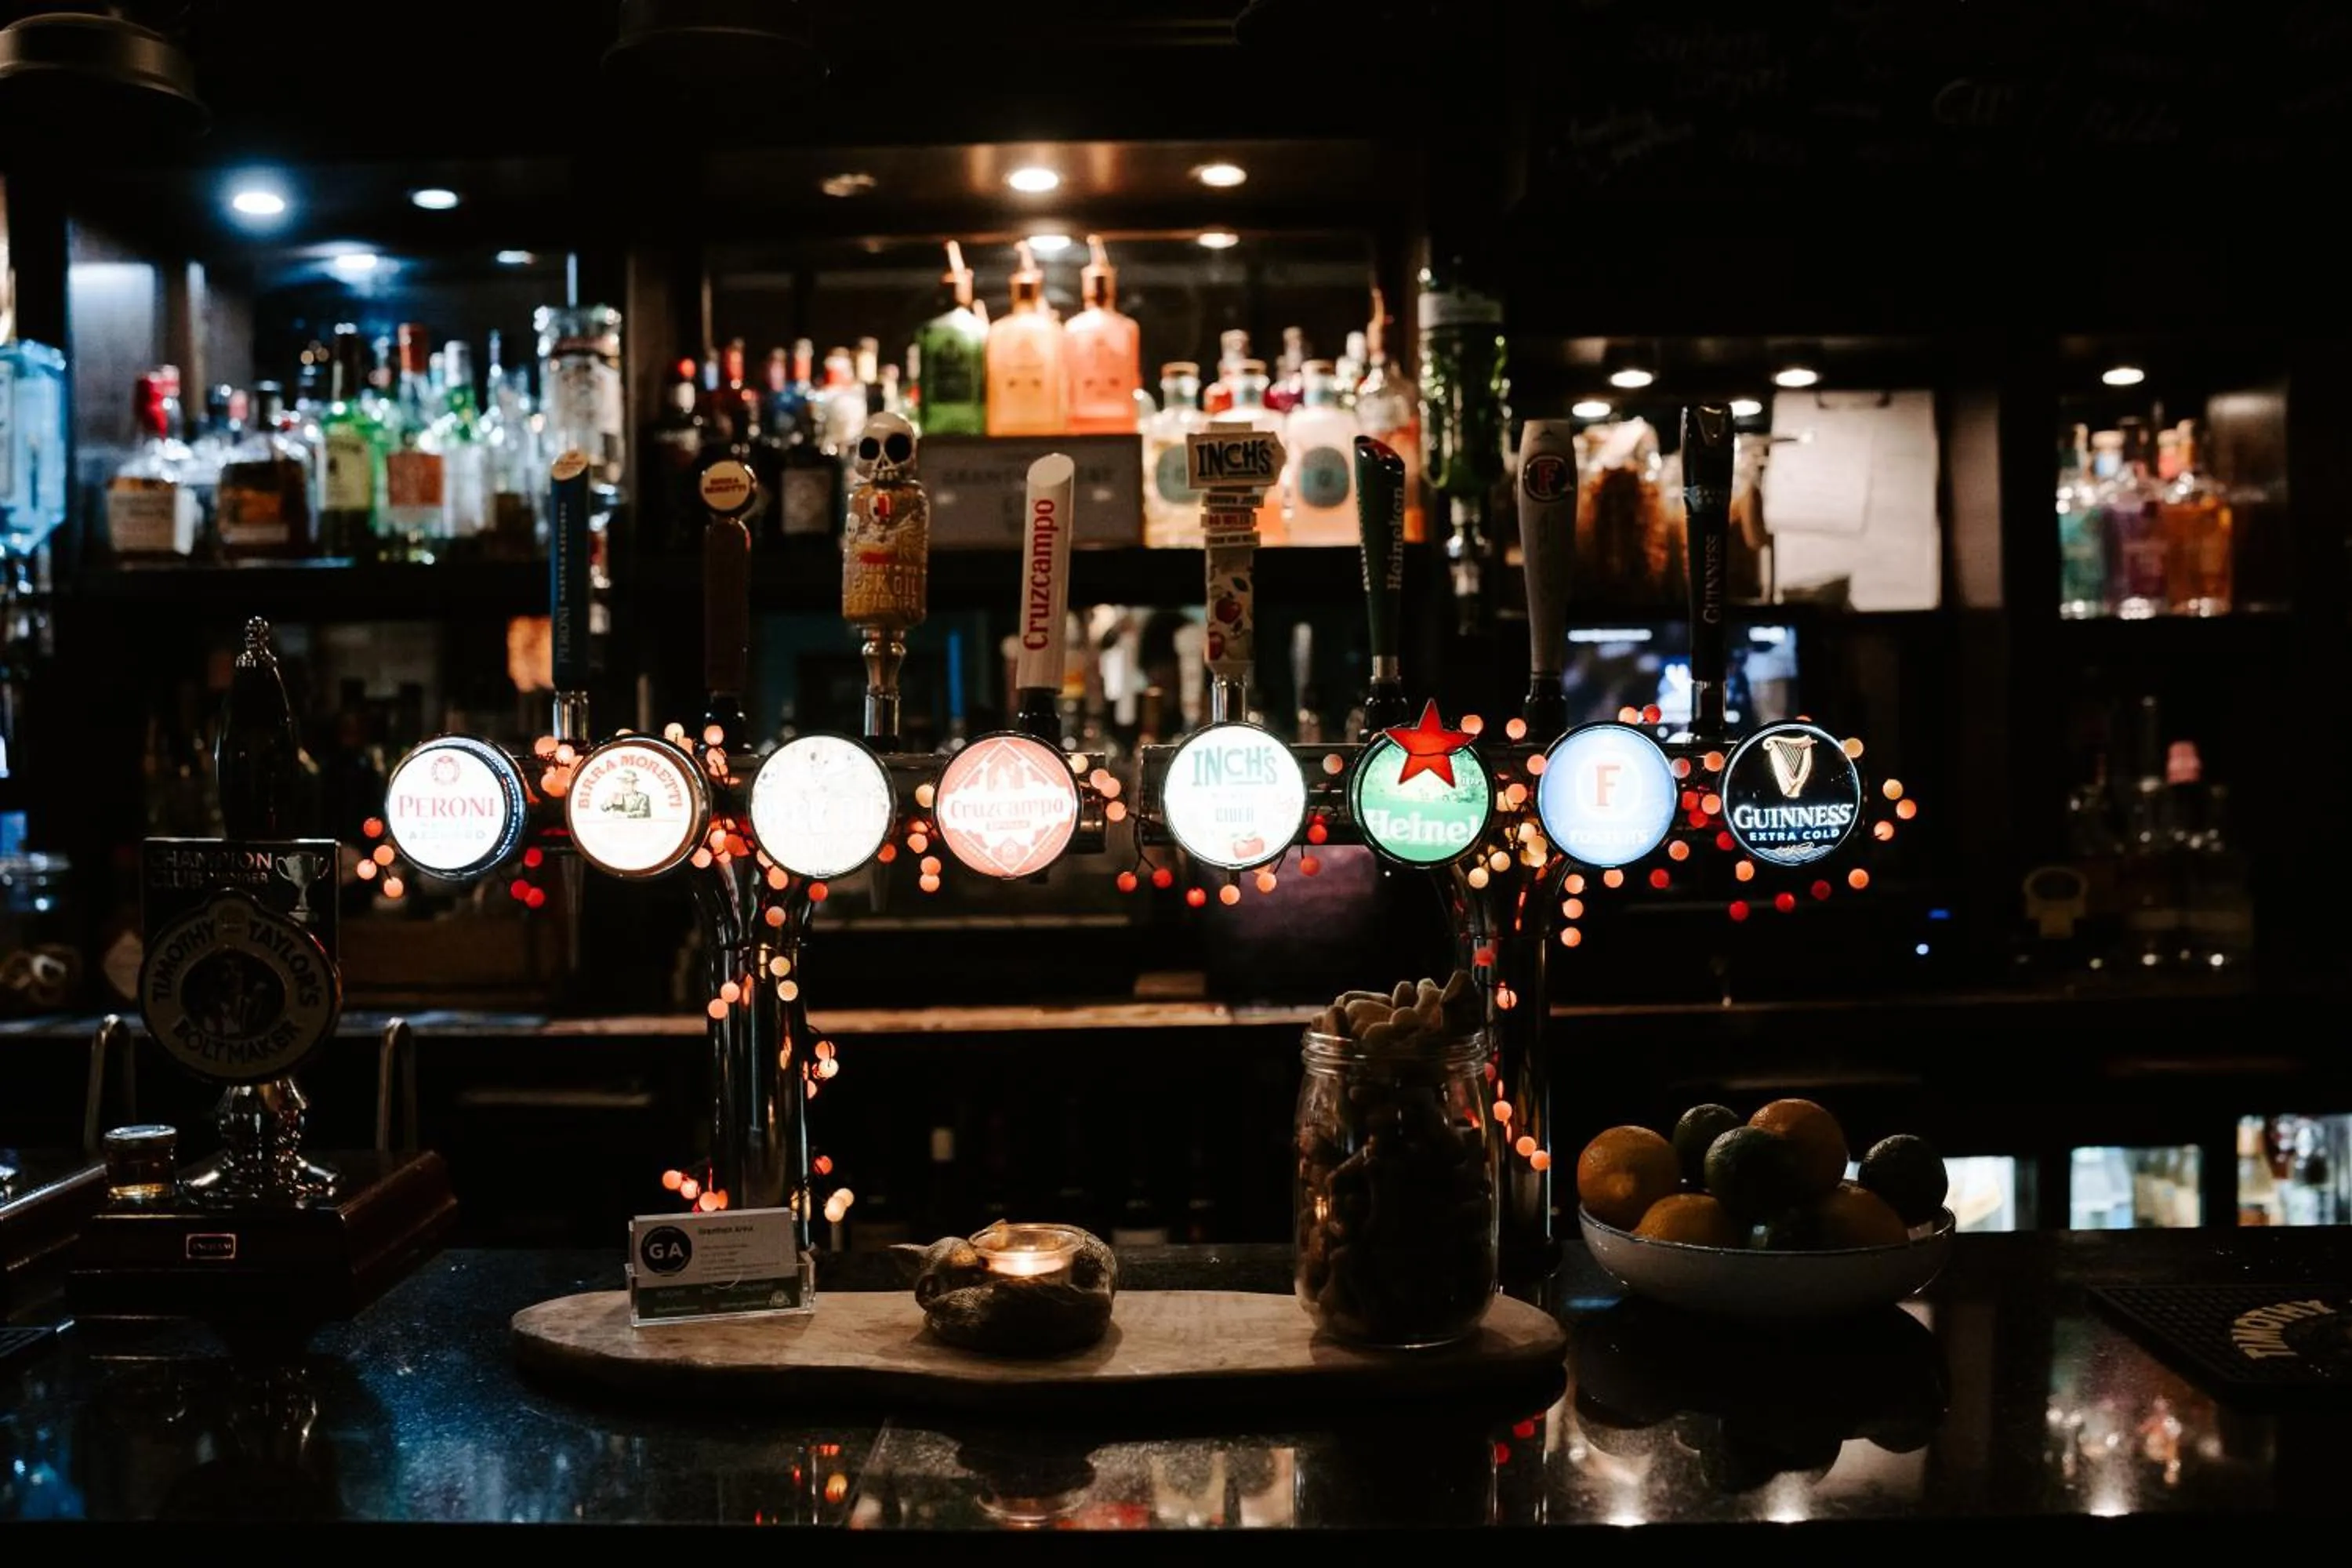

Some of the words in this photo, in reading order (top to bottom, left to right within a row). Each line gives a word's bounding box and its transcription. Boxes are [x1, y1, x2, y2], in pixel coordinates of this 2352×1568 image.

[1196, 439, 1272, 477] INCH'S
[1386, 486, 1404, 590] Heineken
[1022, 499, 1058, 651] Cruzcampo
[1702, 533, 1722, 625] GUINNESS
[577, 757, 618, 810] BIRRA
[620, 753, 684, 808] MORETTI
[1191, 745, 1278, 787] INCH'S
[1595, 763, 1622, 808] F
[398, 794, 495, 818] PERONI
[950, 797, 1065, 820] Cruzcampo
[1733, 804, 1853, 829] GUINNESS
[1749, 832, 1797, 842] EXTRA
[1802, 829, 1841, 840] COLD
[153, 920, 216, 1003] TIMOTHY
[249, 920, 322, 1007] TAYLOR'S
[172, 1018, 303, 1064] BOLTMAKER
